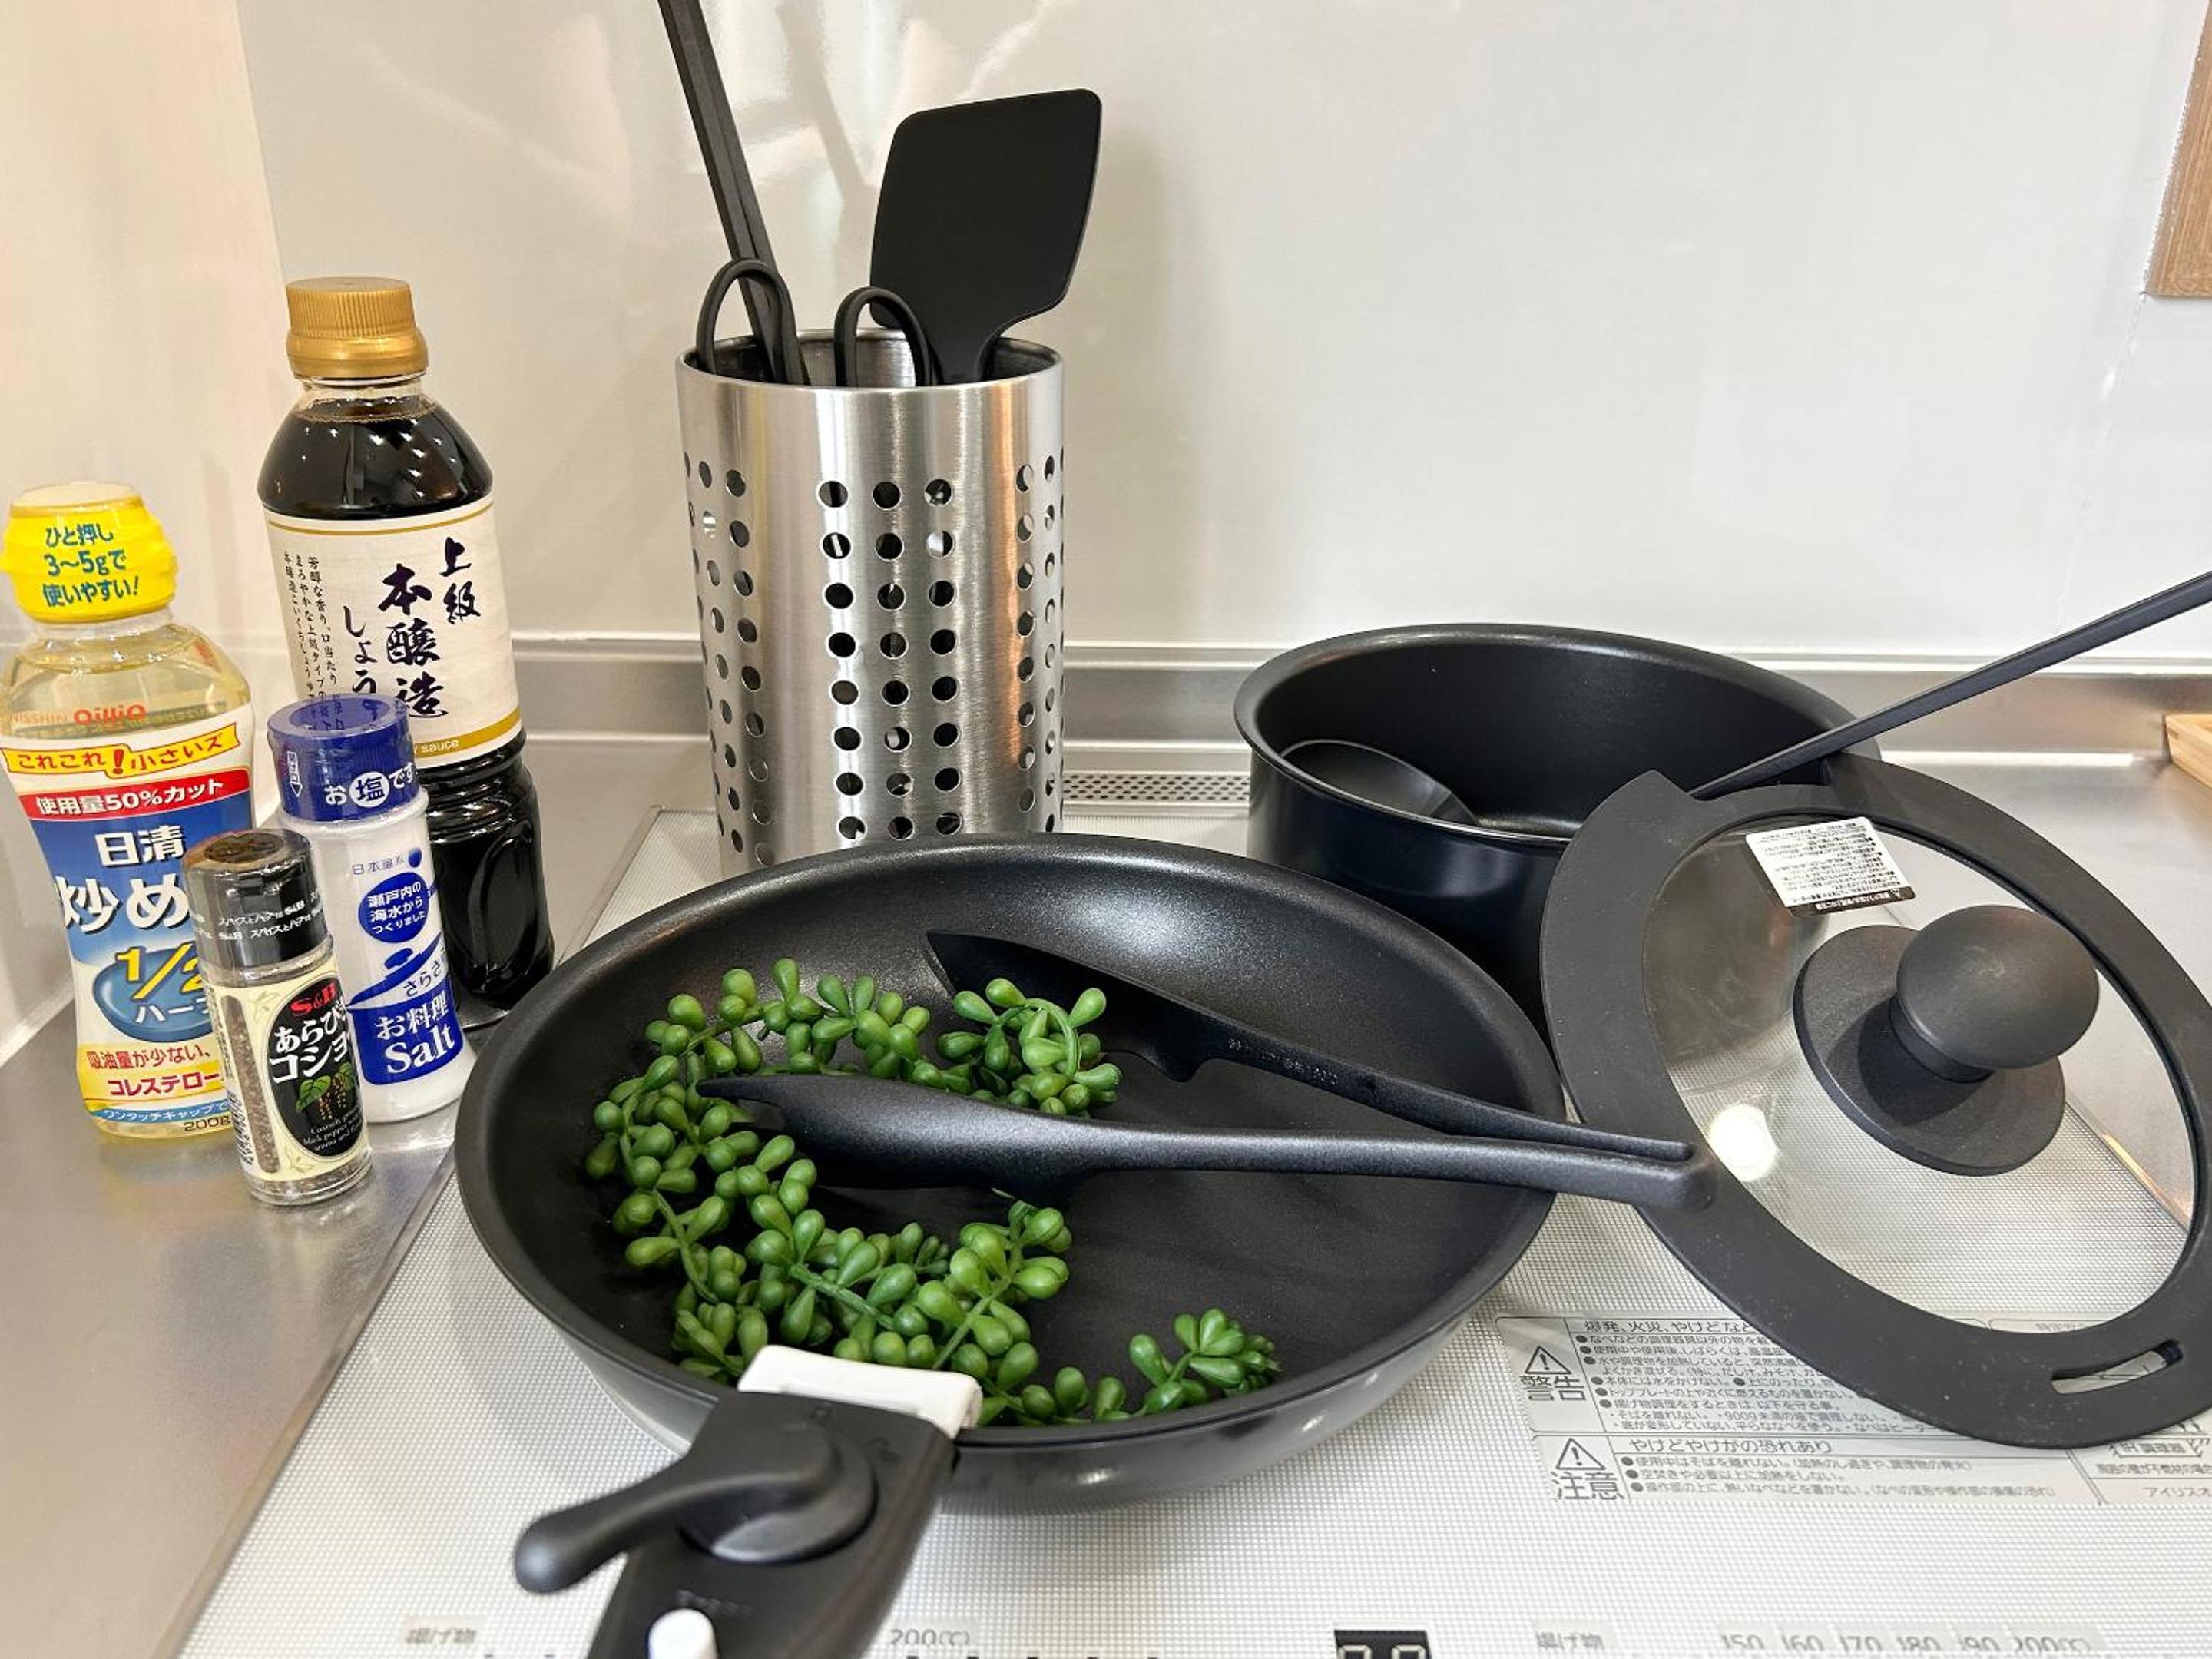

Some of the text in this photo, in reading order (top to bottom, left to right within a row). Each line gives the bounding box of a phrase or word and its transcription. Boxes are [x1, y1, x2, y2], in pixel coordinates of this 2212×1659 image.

[46, 523, 114, 547] ひと押し
[439, 537, 481, 624] 上級
[379, 564, 449, 718] 本醸造
[94, 825, 184, 866] 日清
[368, 882, 421, 908] 瀬戸内の
[370, 896, 422, 922] 海水から
[373, 911, 425, 934] つくりました
[290, 982, 337, 1016] S&B
[374, 990, 449, 1040] お料理
[270, 1031, 349, 1084] コショ
[385, 1023, 455, 1073] Salt
[108, 1072, 224, 1096] コレステロー
[1519, 1376, 1586, 1401] 警告
[1551, 1471, 1624, 1501] 注意
